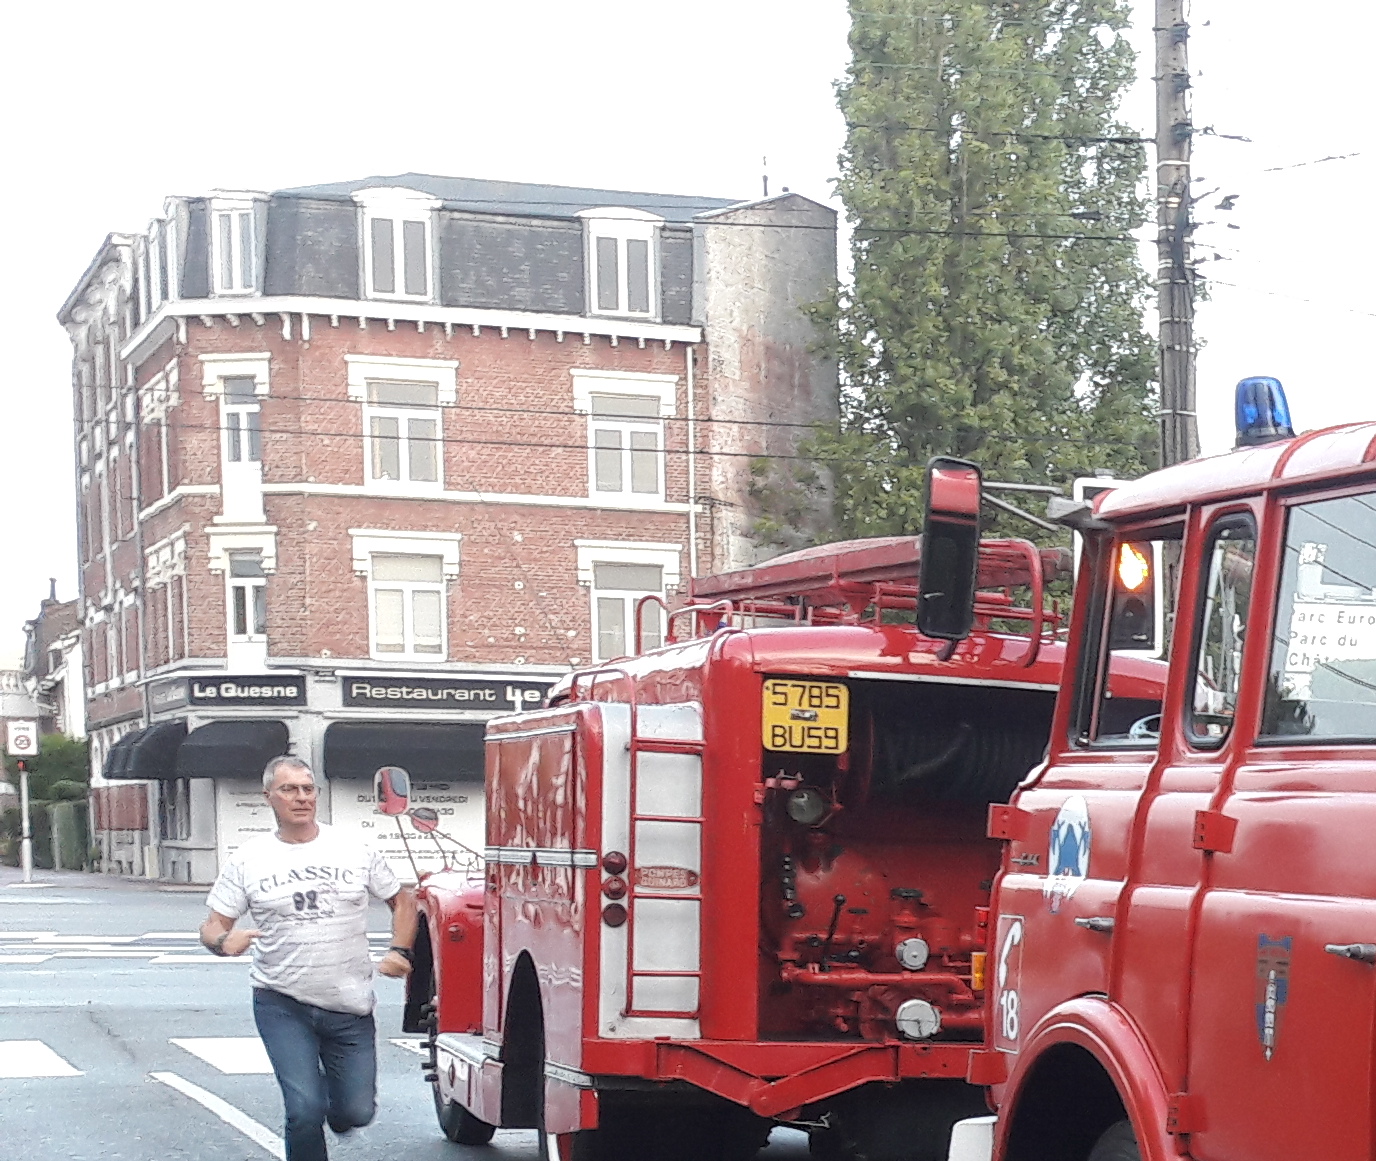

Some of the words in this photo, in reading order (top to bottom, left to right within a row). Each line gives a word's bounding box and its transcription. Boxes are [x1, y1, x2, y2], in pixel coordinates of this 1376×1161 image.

[1297, 611, 1326, 624] arc
[1338, 634, 1358, 646] du
[193, 682, 217, 698] Le
[220, 682, 298, 698] Quesne
[351, 683, 497, 701] Restaurant
[771, 682, 840, 710] 5785
[771, 724, 839, 750] BU59
[1000, 989, 1018, 1040] 18
